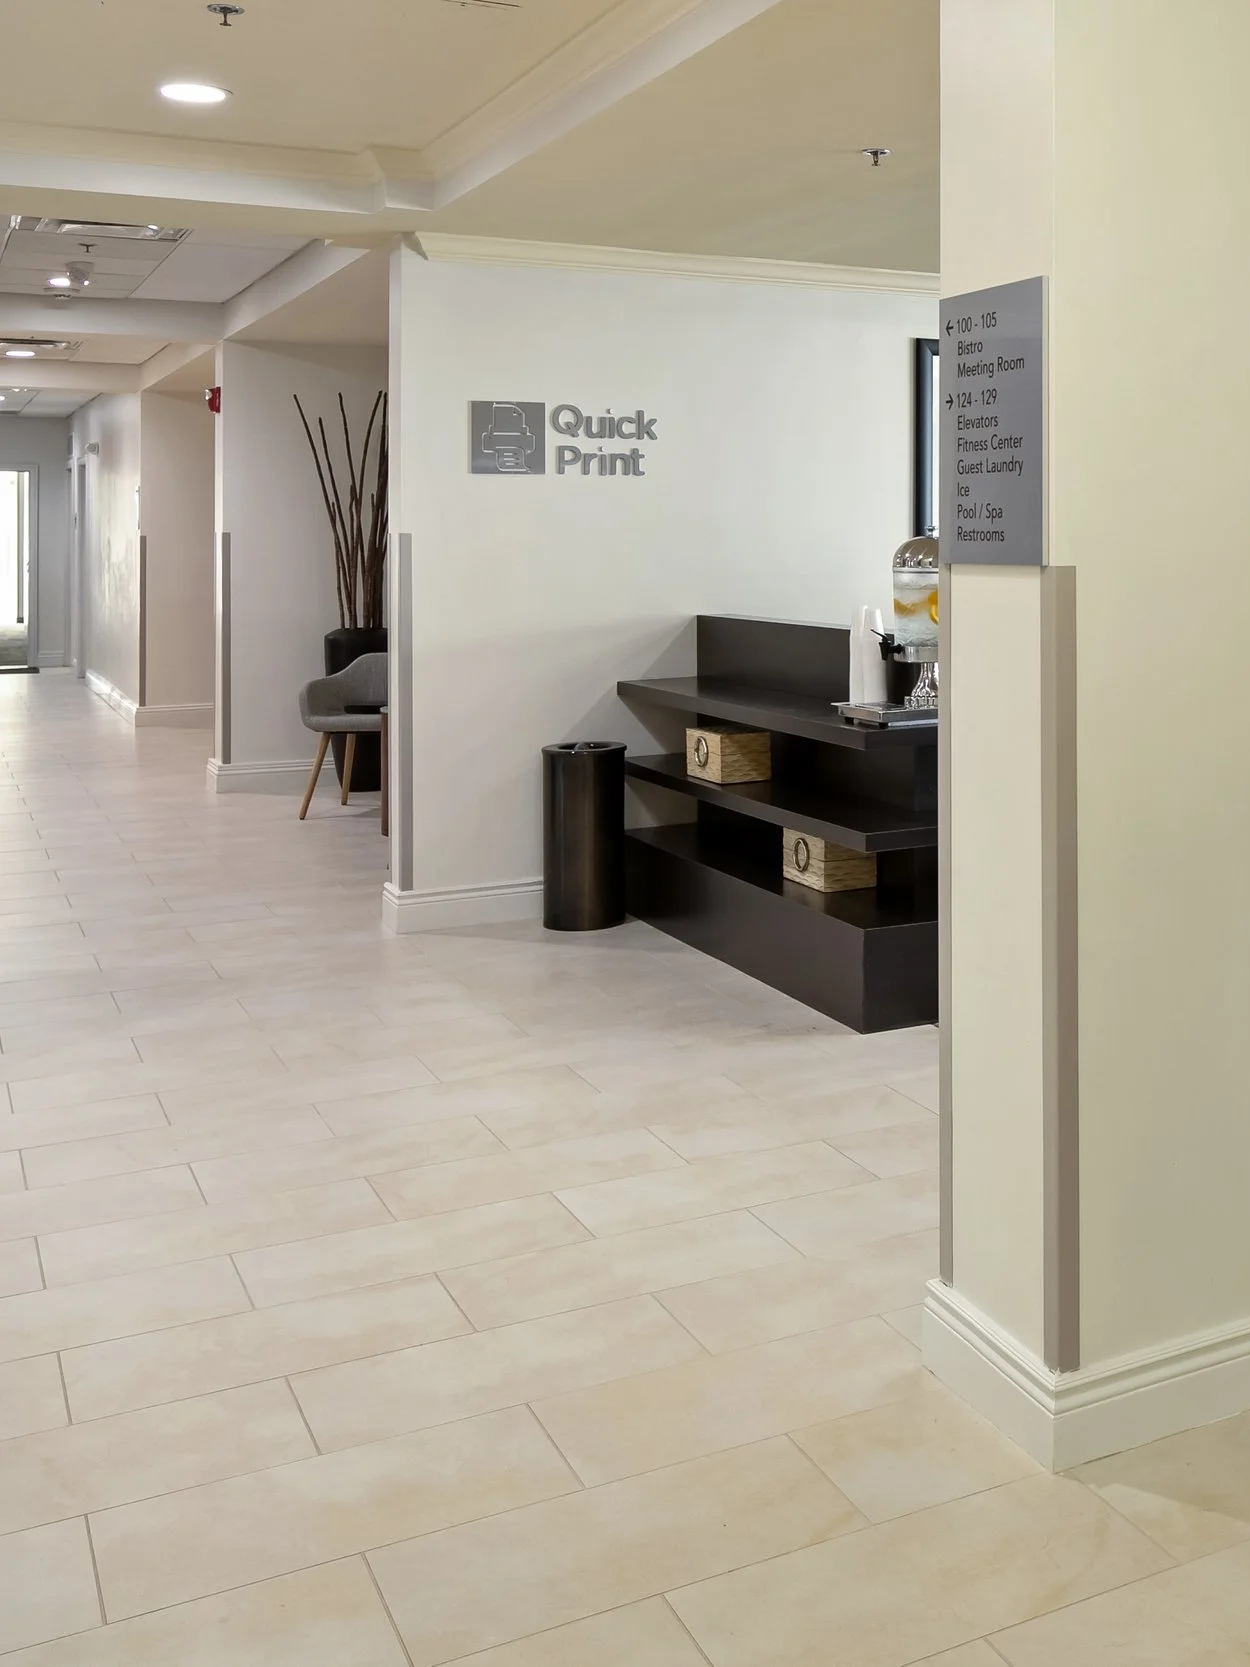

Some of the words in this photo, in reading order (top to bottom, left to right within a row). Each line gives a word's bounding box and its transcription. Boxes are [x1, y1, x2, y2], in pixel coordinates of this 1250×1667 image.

[956, 316, 972, 334] 100
[981, 311, 997, 329] 105
[957, 340, 983, 356] Bistro
[957, 360, 994, 378] Meeting
[997, 356, 1025, 373] Room
[956, 392, 972, 408] 124
[981, 388, 997, 405] 129
[550, 403, 658, 440] Quick
[957, 414, 998, 430] Elevators
[957, 437, 988, 452] Fitness
[990, 434, 1023, 450] Center
[556, 445, 646, 476] Print
[957, 459, 983, 475] Guest
[986, 455, 1024, 476] Laundry
[957, 482, 970, 496] Ice
[957, 503, 976, 519] Pool
[985, 503, 1003, 525] Spa
[957, 526, 1005, 542] Restrooms
